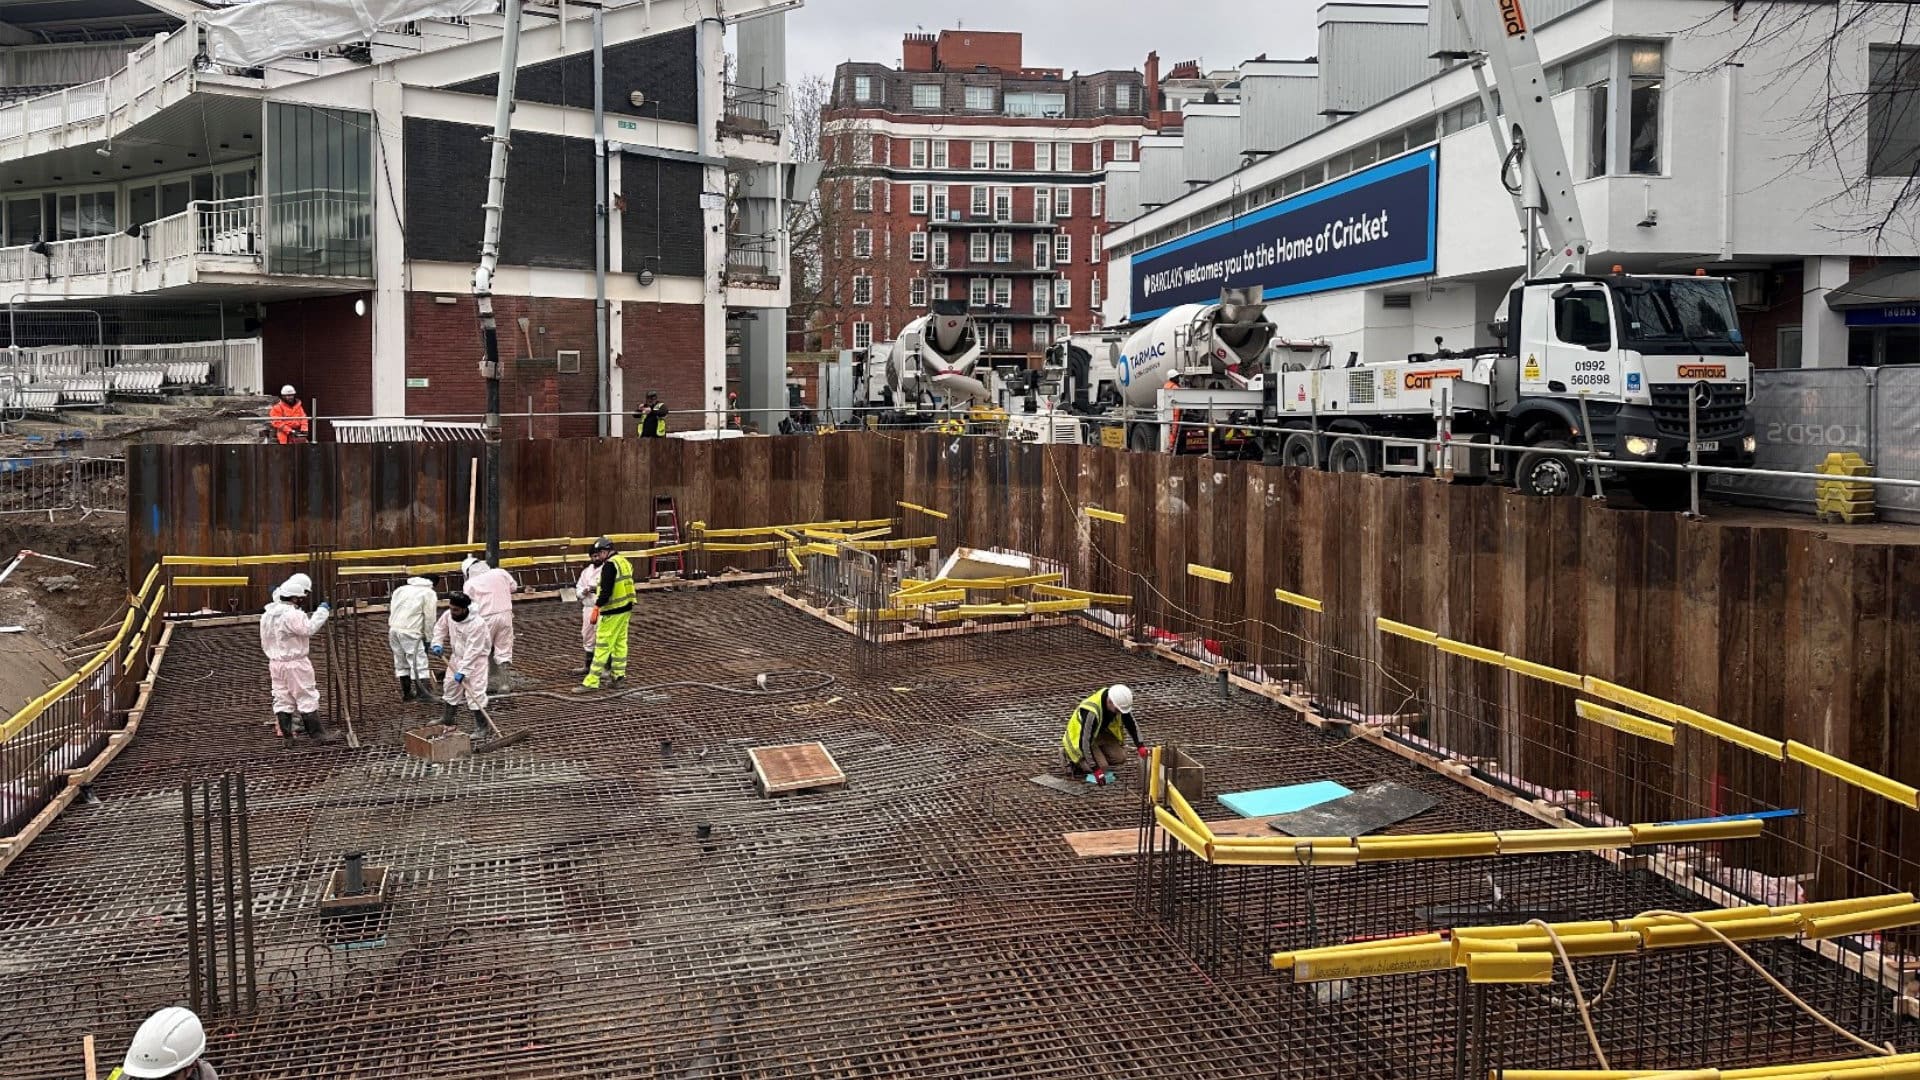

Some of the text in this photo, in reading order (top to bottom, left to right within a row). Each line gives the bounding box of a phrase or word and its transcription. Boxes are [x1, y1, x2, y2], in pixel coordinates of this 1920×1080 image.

[1150, 209, 1389, 293] BARCLAYS welcomes you to the Home of Cricket
[1130, 342, 1166, 369] TARMAC
[1575, 361, 1605, 371] 01992
[1571, 374, 1610, 385] 560898
